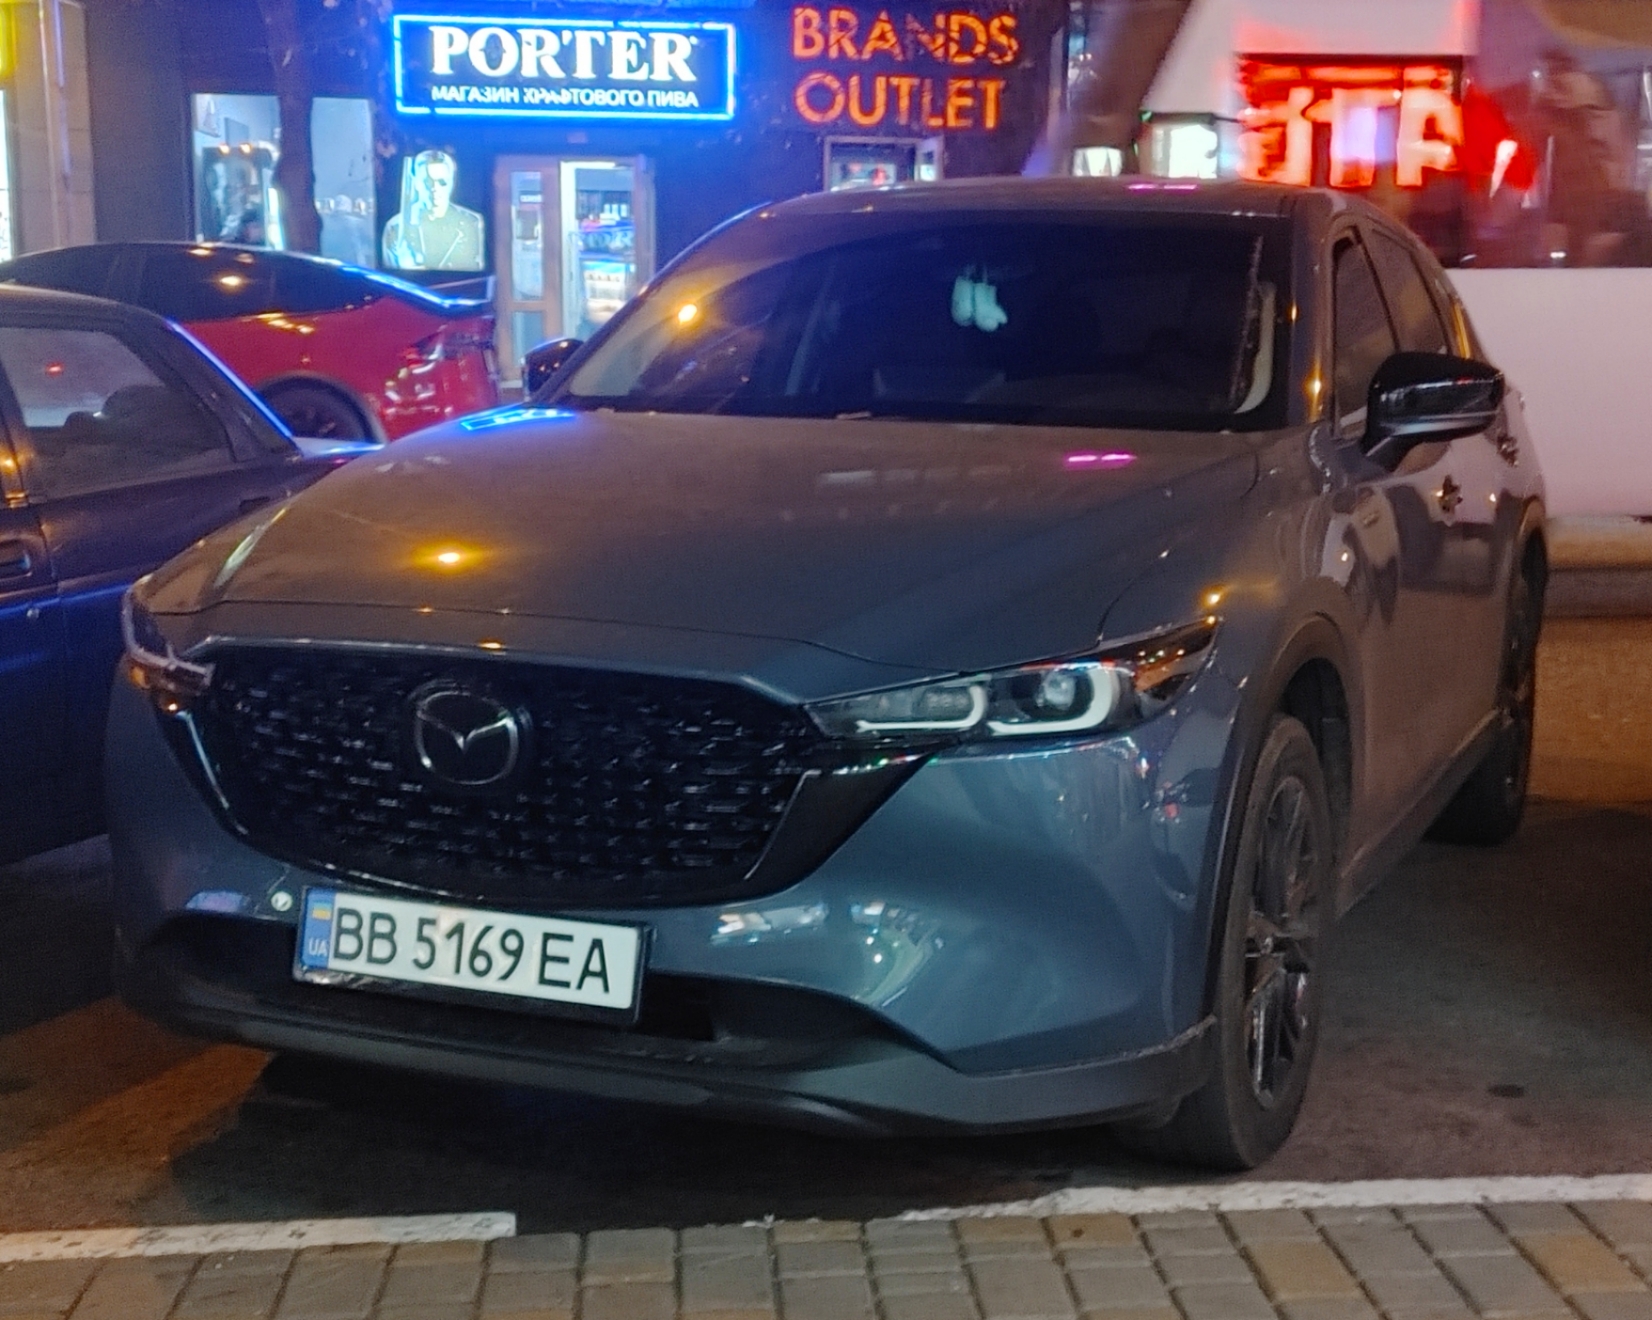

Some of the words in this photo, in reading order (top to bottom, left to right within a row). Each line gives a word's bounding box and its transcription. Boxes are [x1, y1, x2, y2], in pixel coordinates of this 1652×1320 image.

[428, 25, 698, 82] PORTER
[792, 7, 1019, 64] BRANDS
[431, 85, 519, 104] МАГАЗИН
[647, 90, 699, 108] ПИВА
[795, 72, 1006, 130] OUTLET
[308, 937, 328, 957] UA
[334, 907, 397, 965] BB
[412, 917, 524, 982] 5169
[537, 931, 610, 994] EA
